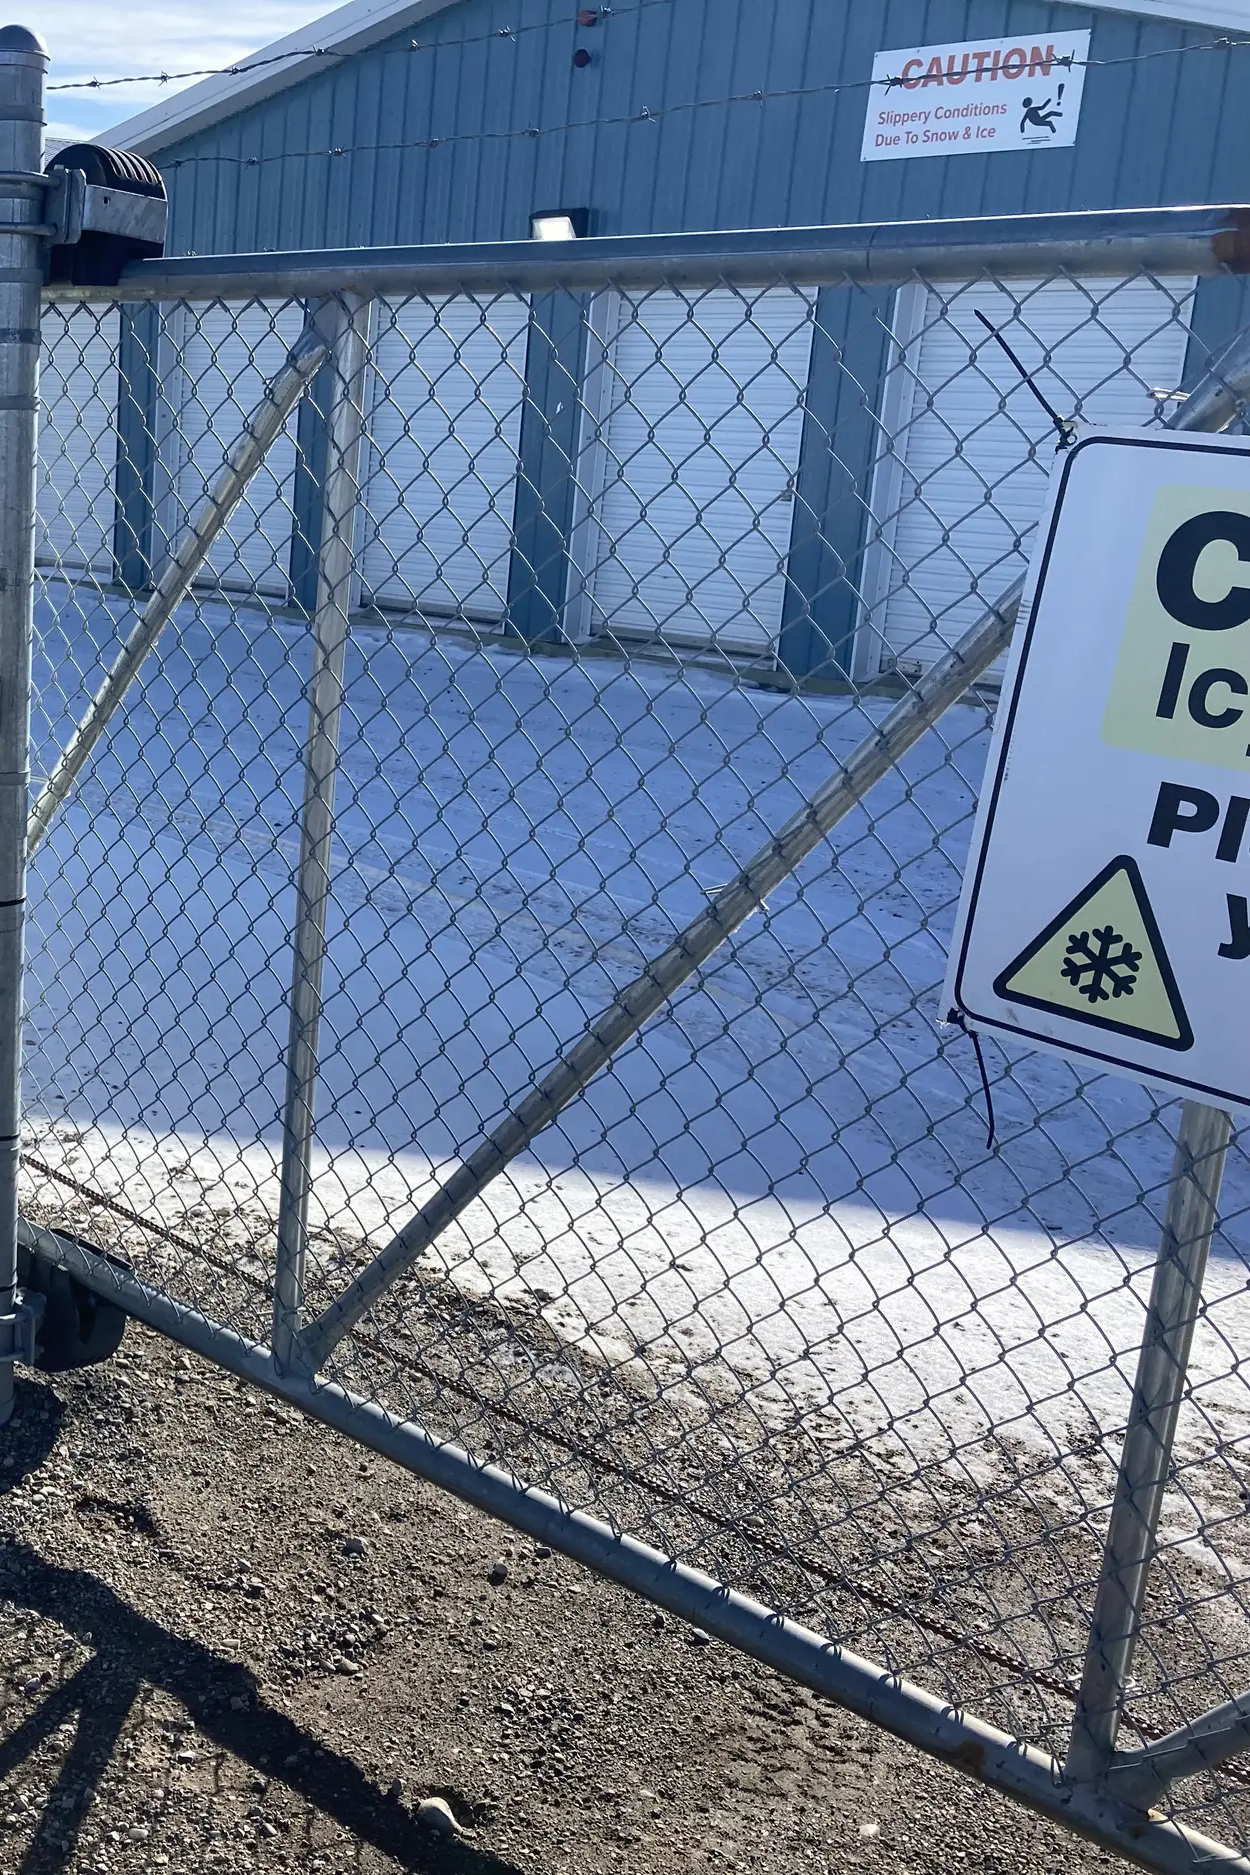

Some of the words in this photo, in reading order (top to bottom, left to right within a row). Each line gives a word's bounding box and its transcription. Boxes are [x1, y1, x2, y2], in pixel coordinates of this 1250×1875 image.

[901, 45, 1055, 90] CAUTION
[877, 107, 932, 127] Slippery
[934, 102, 1007, 119] Conditions
[875, 133, 901, 147] Due
[905, 131, 918, 145] To
[922, 128, 959, 143] Snow
[963, 127, 972, 140] &
[976, 125, 996, 138] Ice
[1155, 641, 1250, 757] Ic
